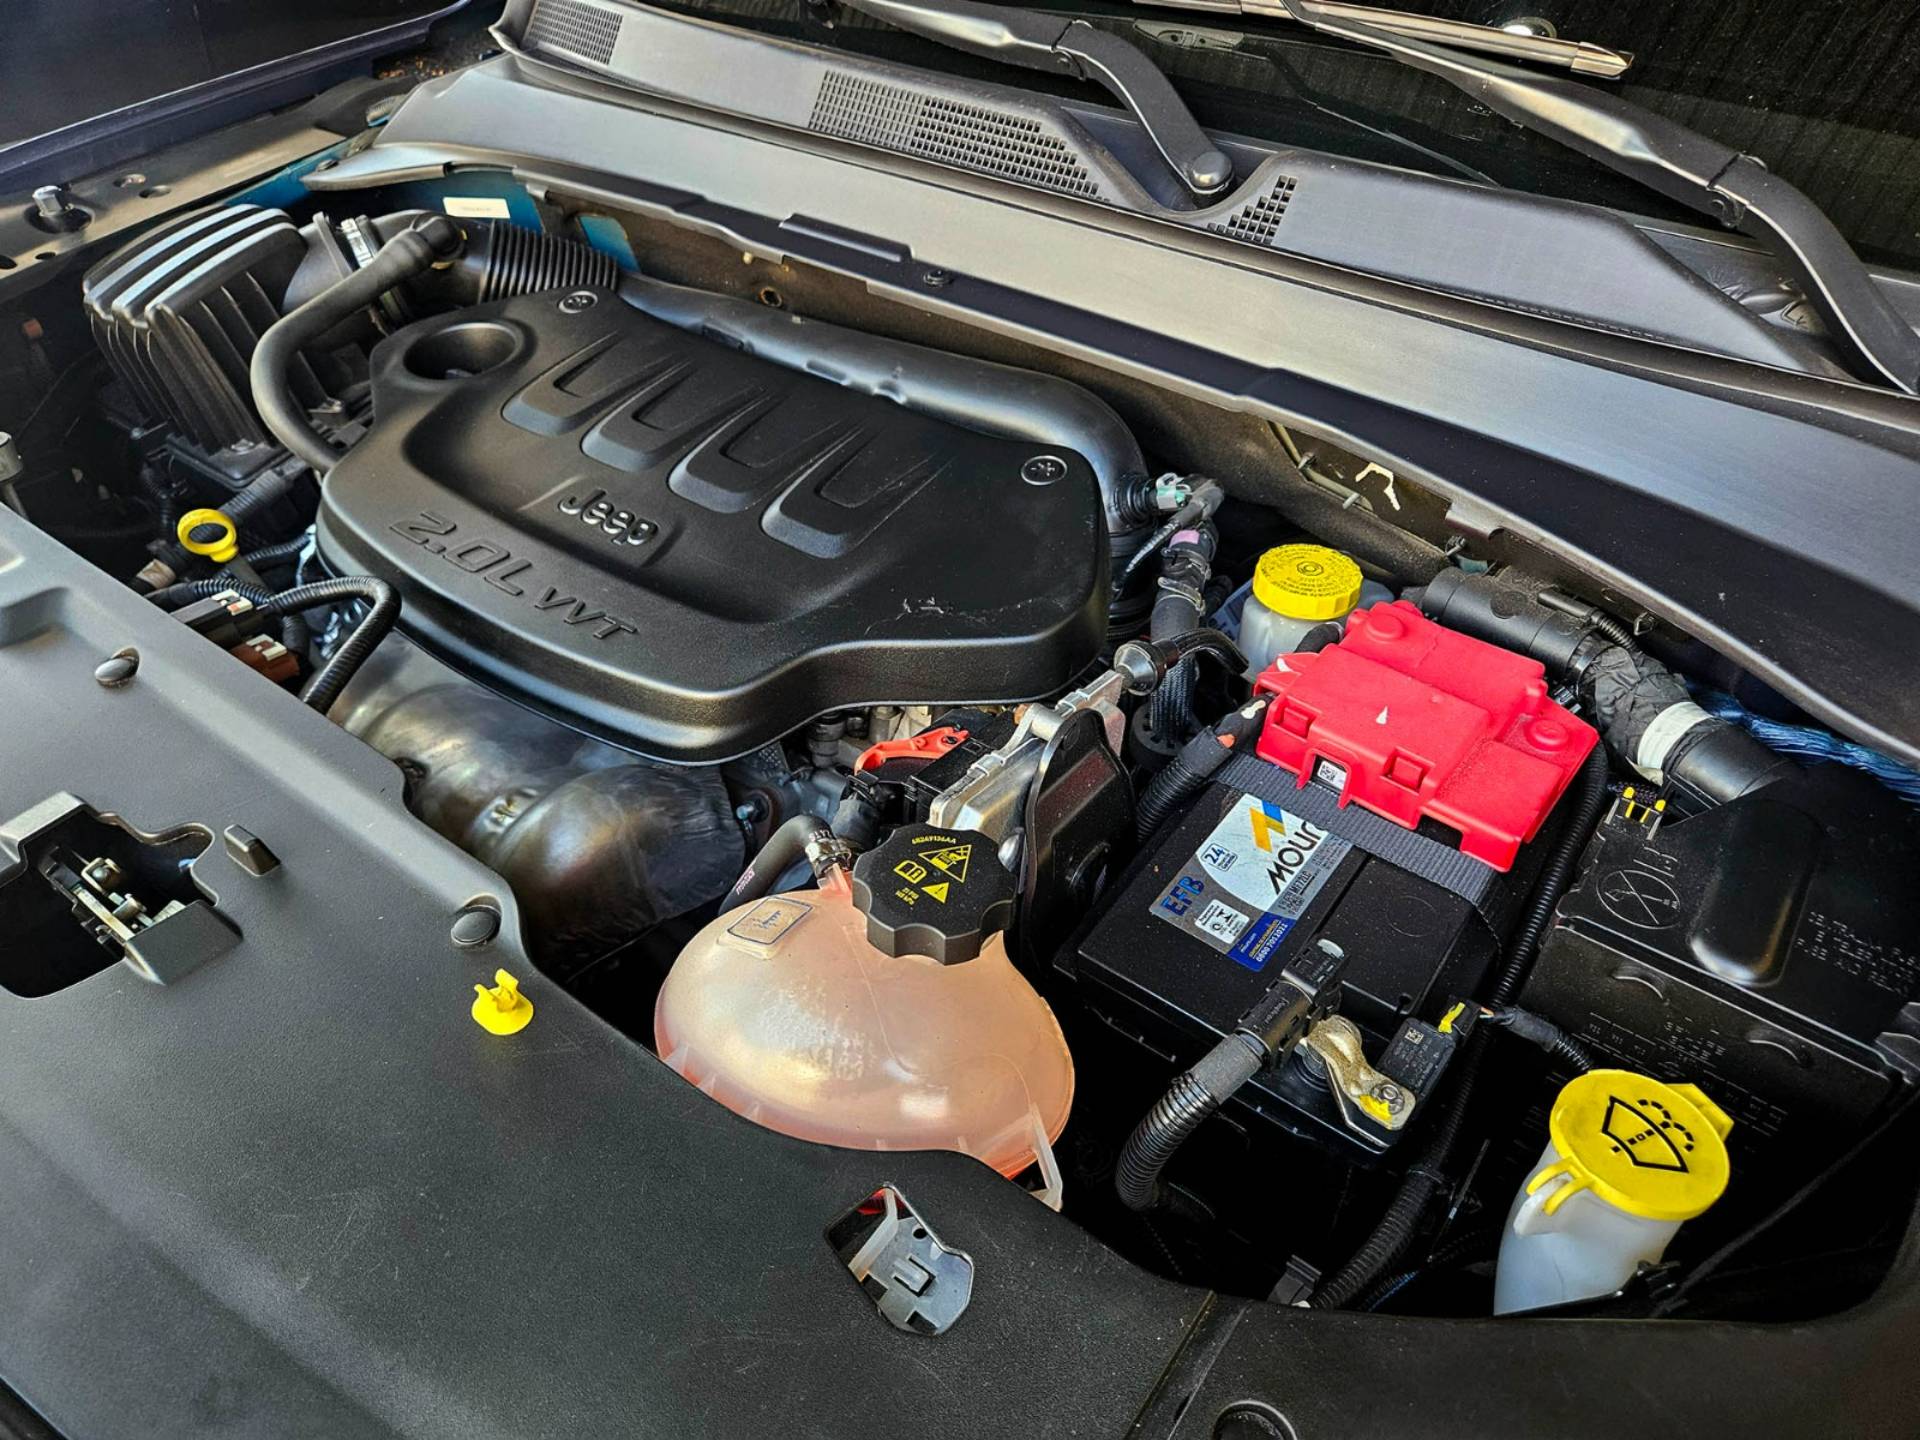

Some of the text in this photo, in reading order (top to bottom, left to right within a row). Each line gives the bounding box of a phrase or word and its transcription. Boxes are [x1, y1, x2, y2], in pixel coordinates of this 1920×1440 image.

[557, 488, 659, 546] Jeep
[389, 510, 639, 640] 2.0L VVT
[1203, 846, 1225, 865] 24
[1266, 821, 1322, 896] MOUR
[1161, 875, 1205, 917] EFB
